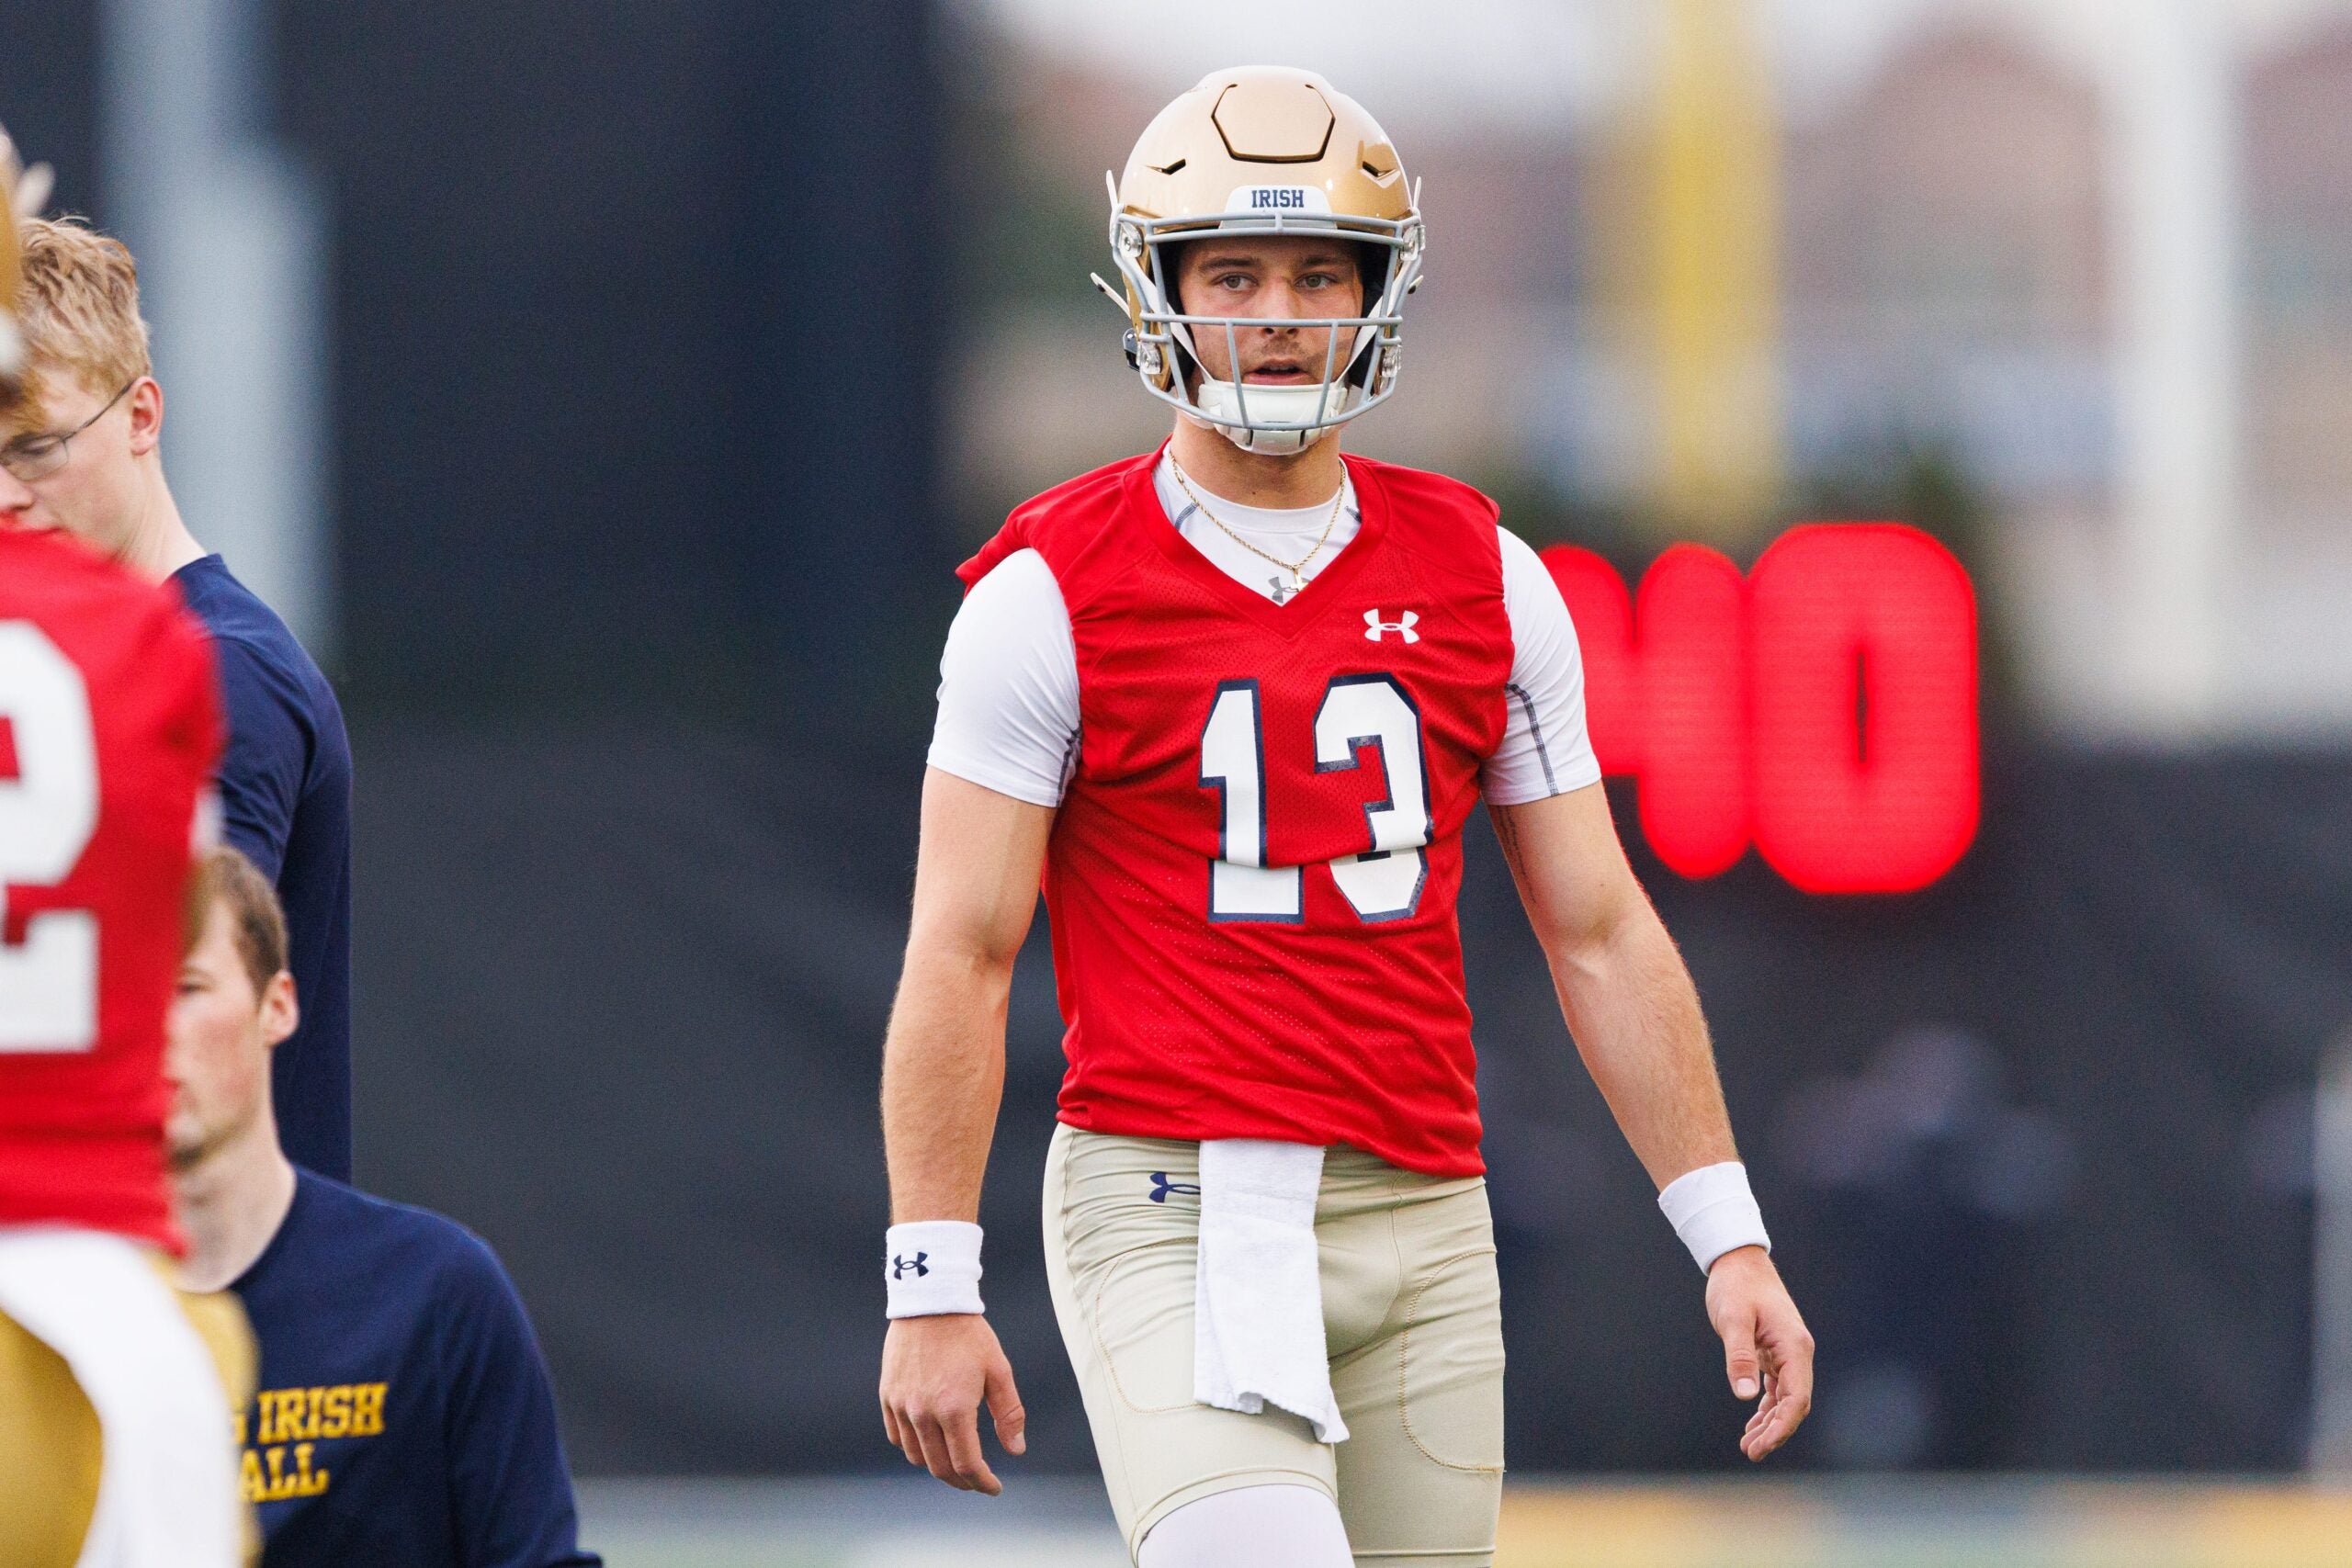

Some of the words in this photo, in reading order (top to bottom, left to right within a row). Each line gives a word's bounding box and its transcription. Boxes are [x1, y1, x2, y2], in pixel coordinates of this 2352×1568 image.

[1251, 189, 1305, 209] IRISH
[1198, 671, 1434, 924] 13
[256, 1382, 388, 1444] IRISH
